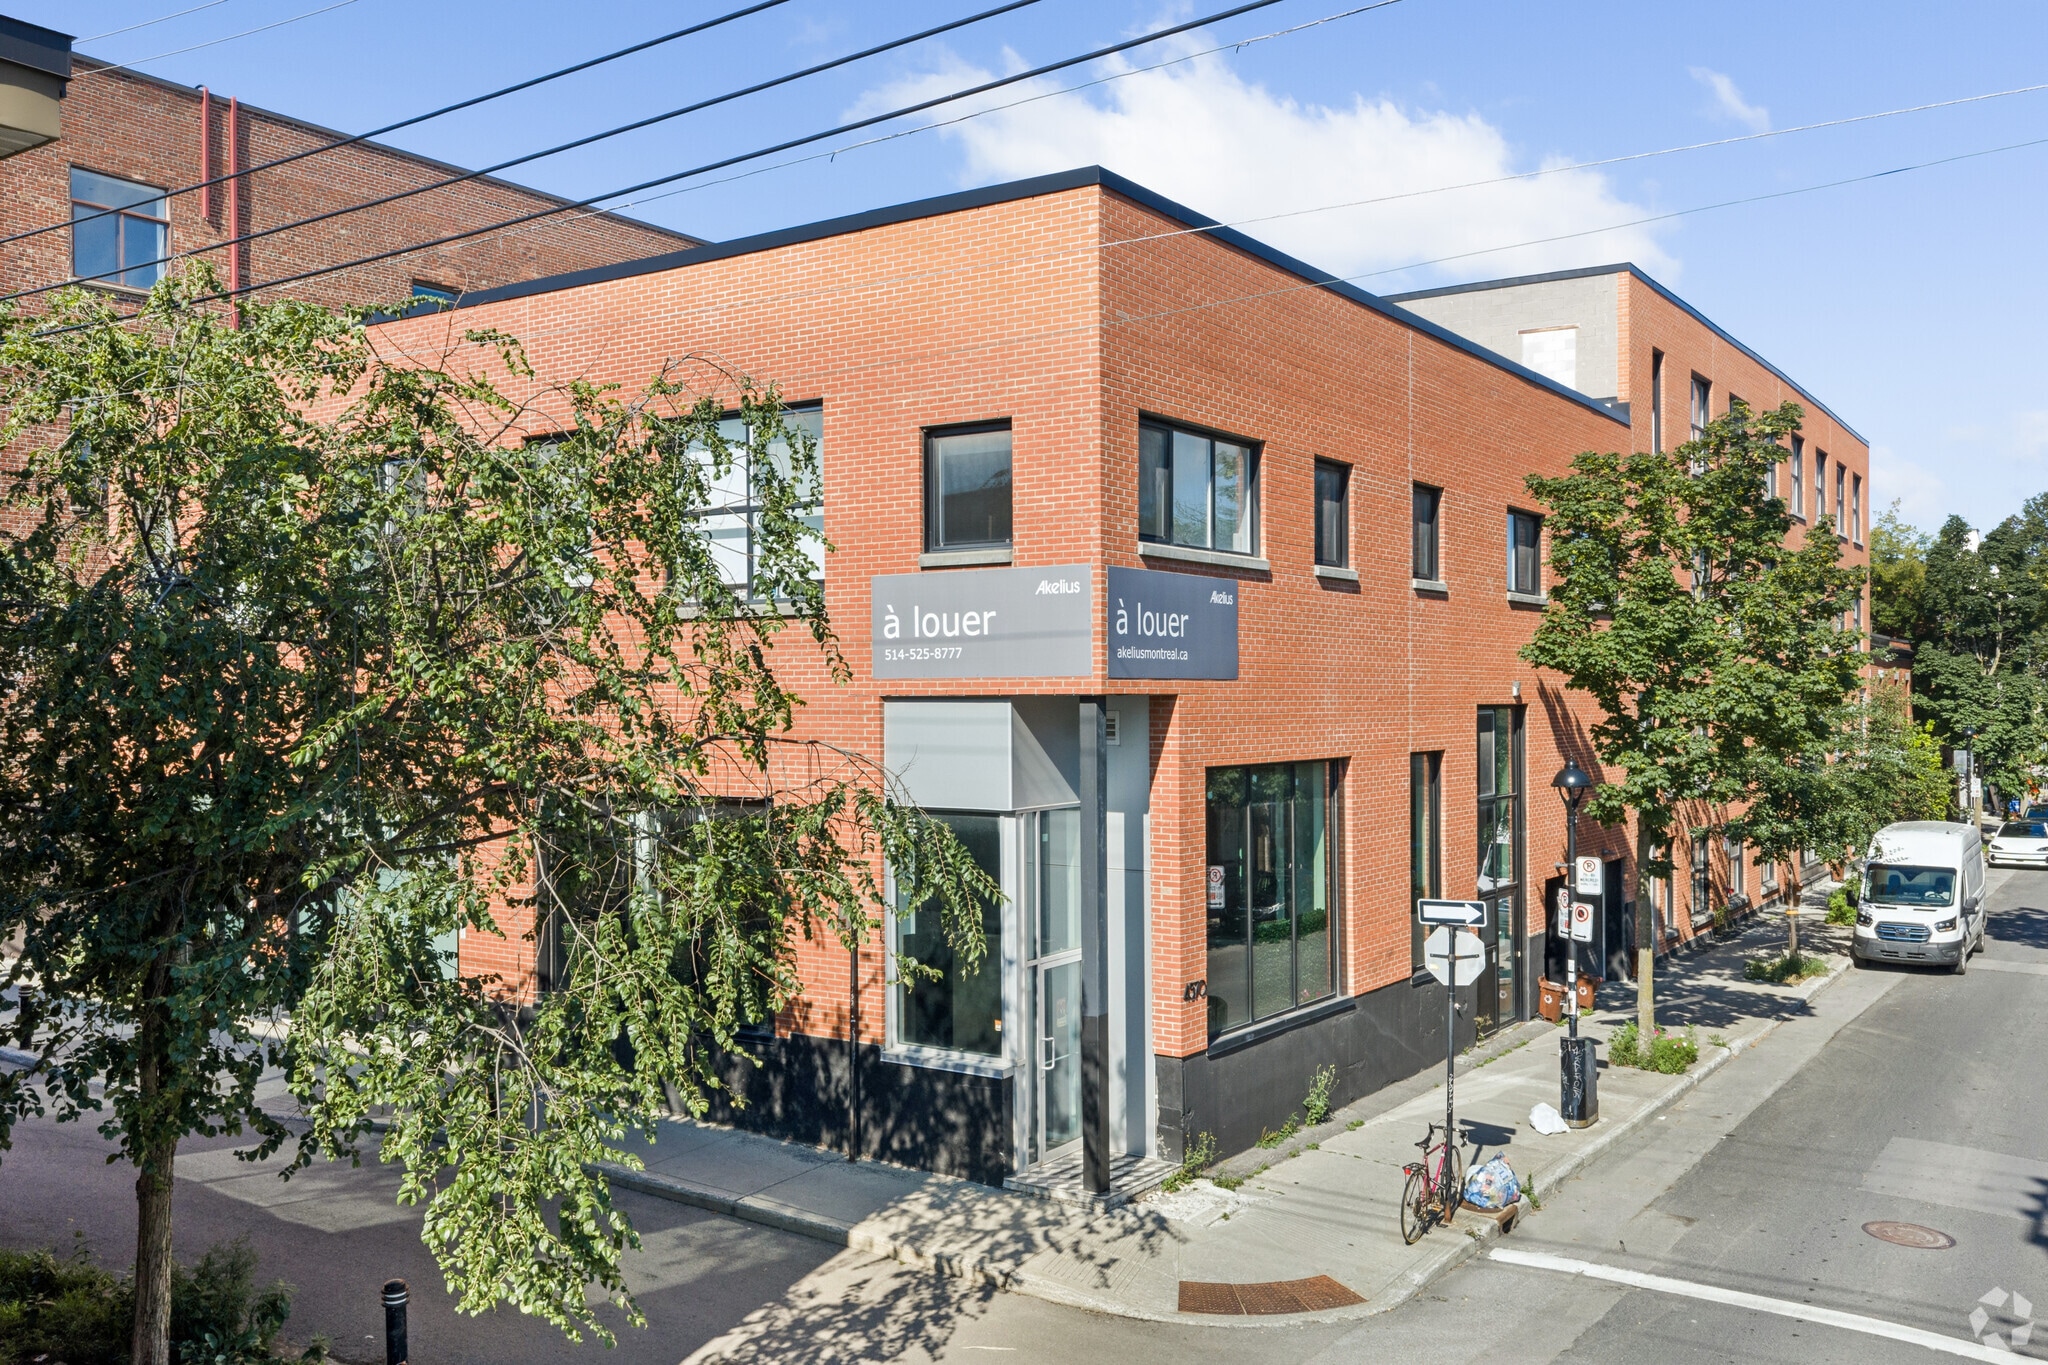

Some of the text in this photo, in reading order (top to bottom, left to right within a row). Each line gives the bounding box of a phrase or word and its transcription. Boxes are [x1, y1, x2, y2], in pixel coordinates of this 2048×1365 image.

[1035, 579, 1081, 595] Akelius
[1209, 590, 1234, 606] Akelius
[883, 604, 996, 640] à louer
[1116, 598, 1190, 638] à louer
[884, 646, 963, 661] 514-525-8777
[1116, 645, 1189, 661] akeliusmontreal.ca
